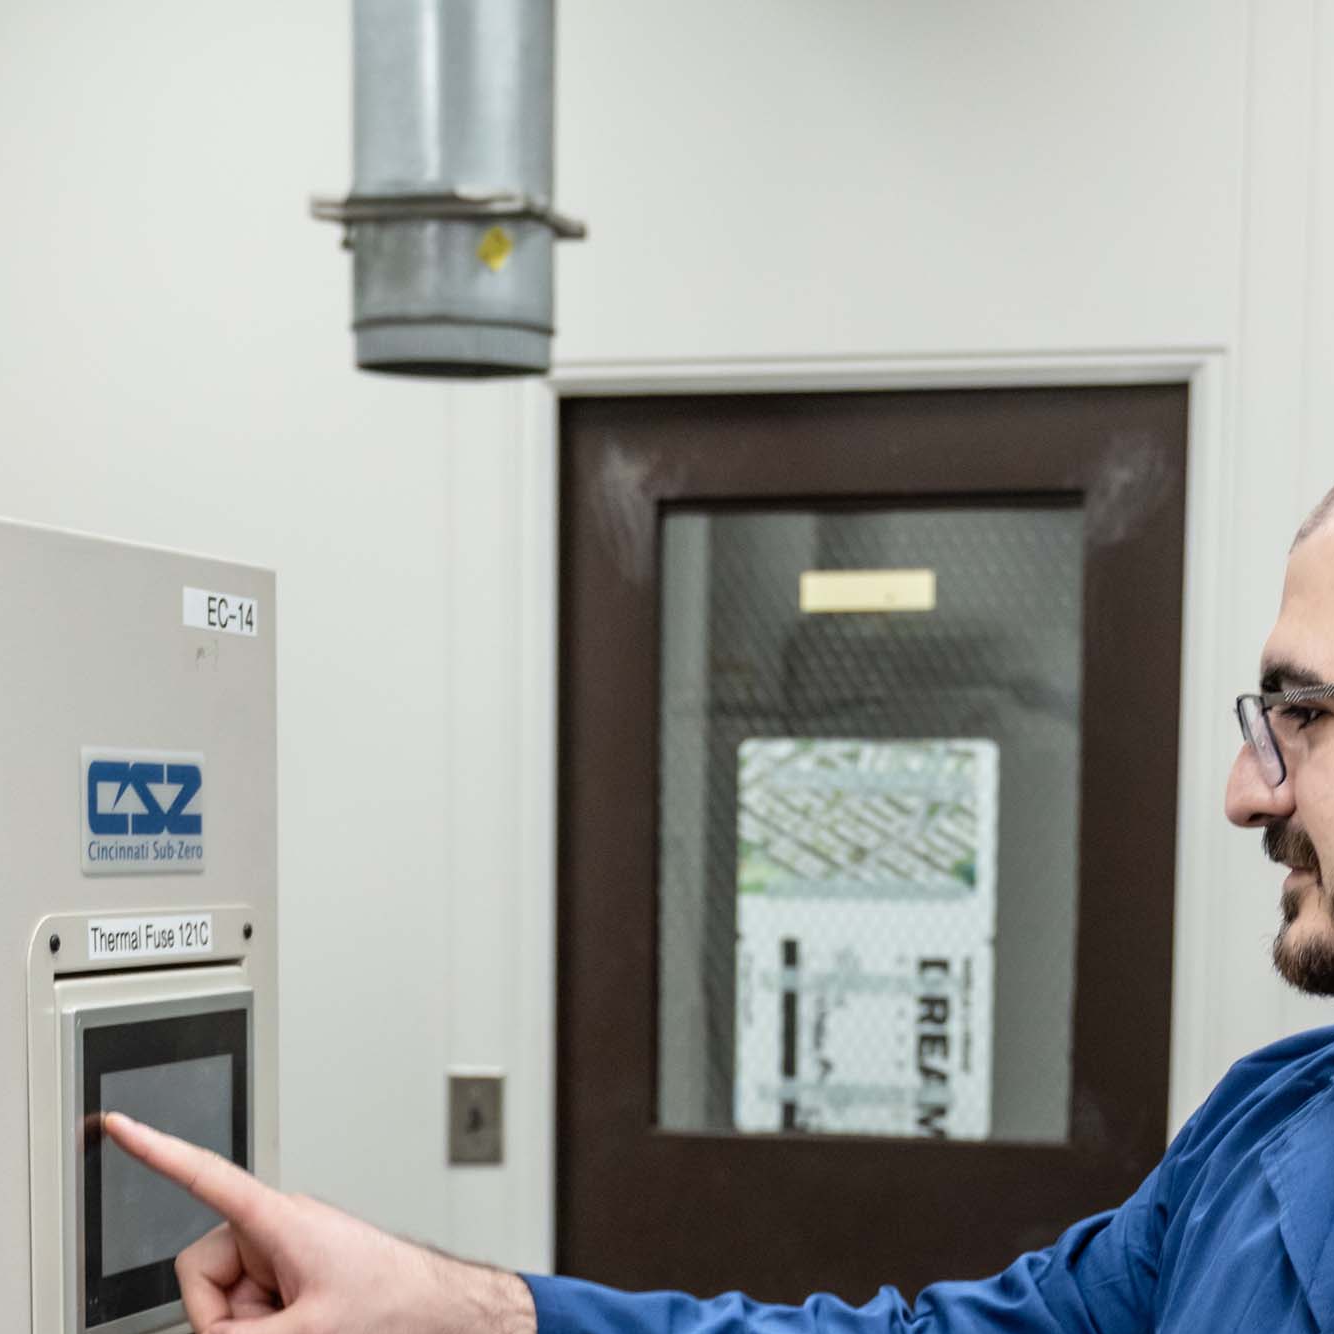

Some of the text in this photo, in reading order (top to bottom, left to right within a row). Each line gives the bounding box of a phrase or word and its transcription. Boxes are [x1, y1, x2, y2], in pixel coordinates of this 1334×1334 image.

[207, 596, 254, 633] EC-14
[87, 760, 203, 836] CSZ
[88, 841, 149, 861] Cincinnati
[91, 921, 209, 953] Thermal Fuse 121C
